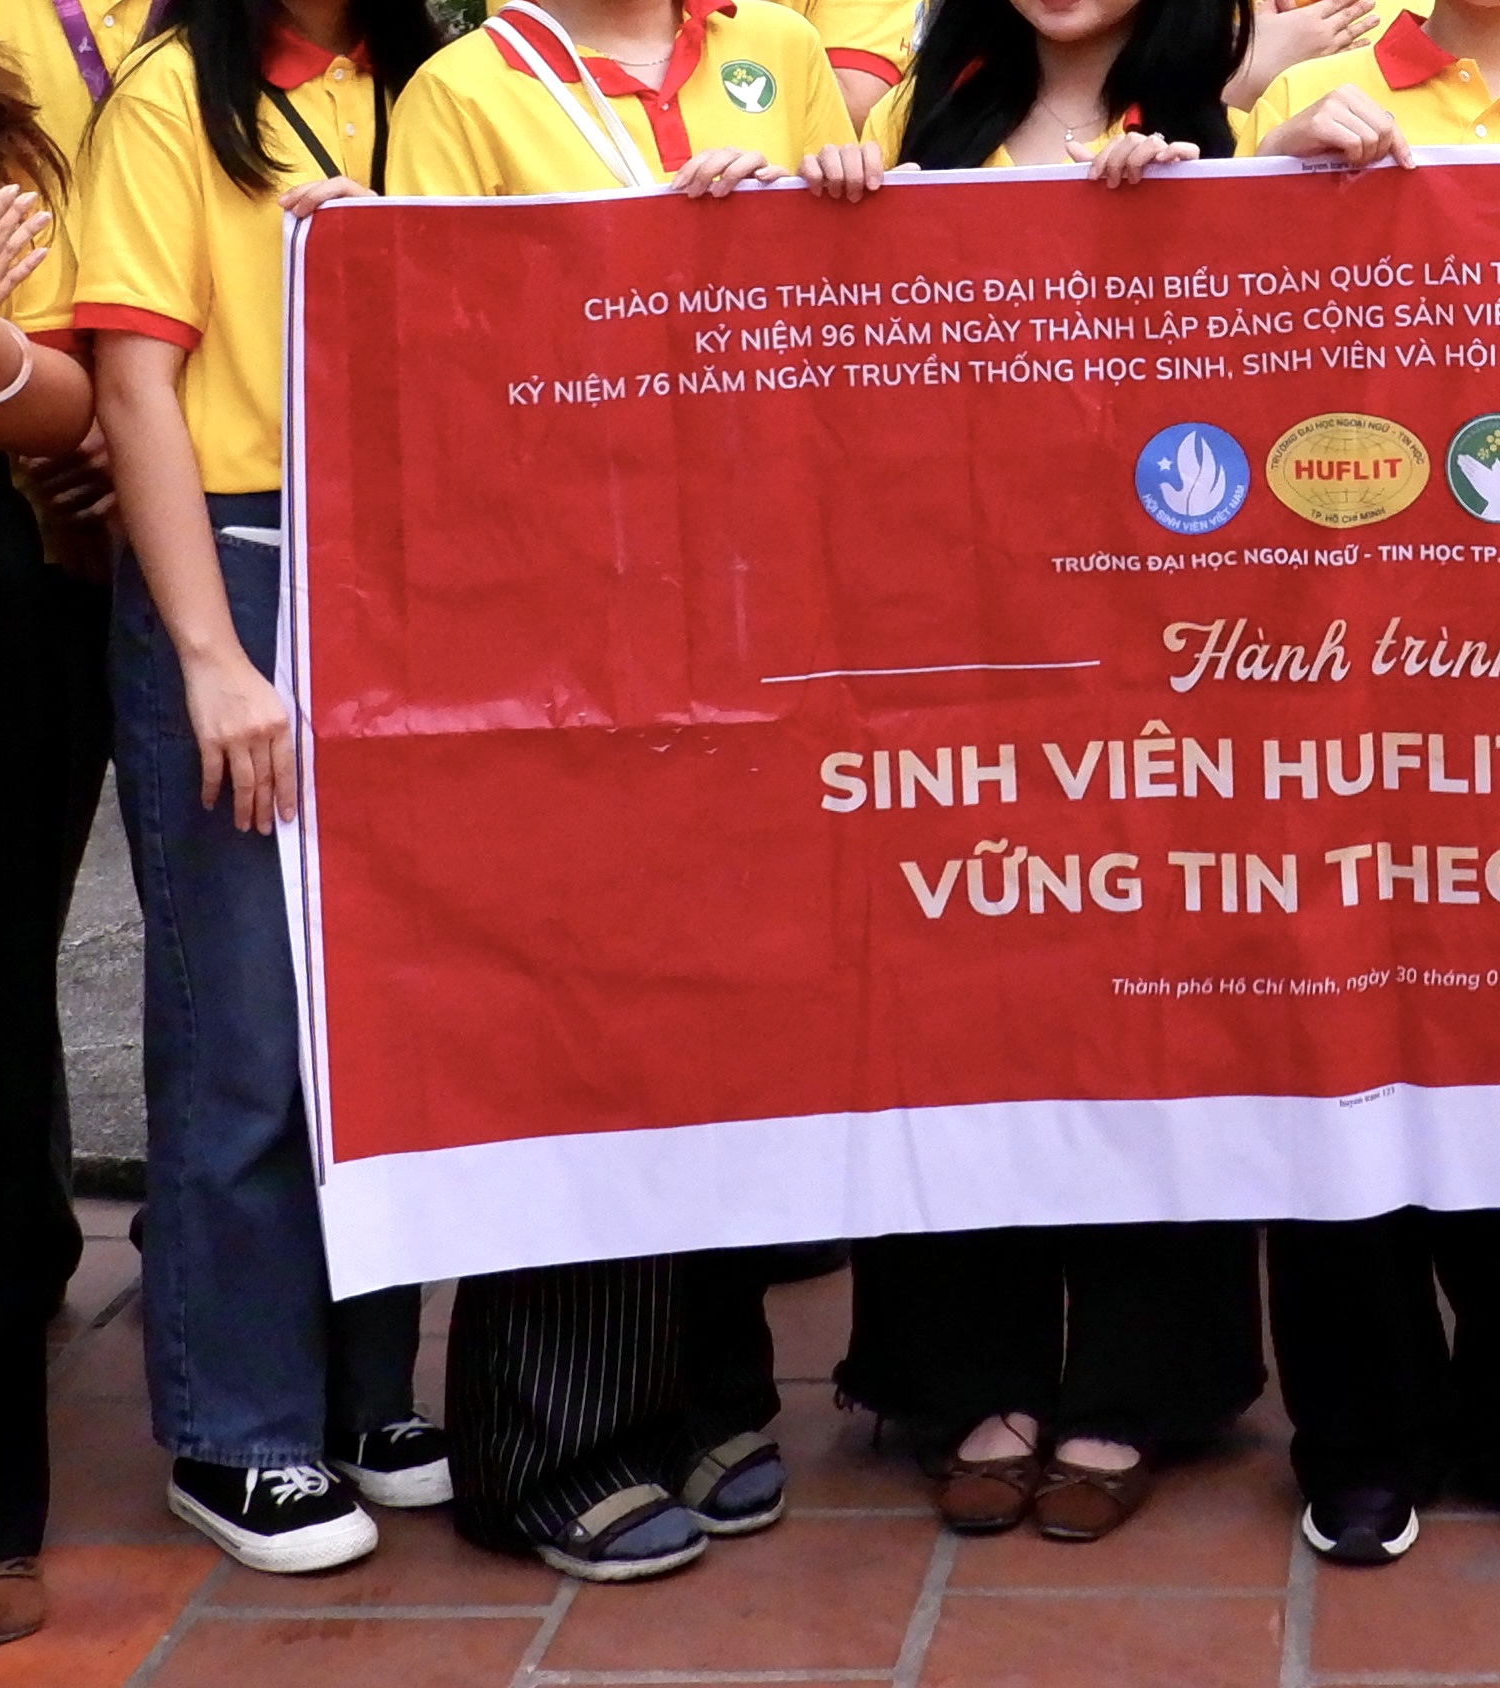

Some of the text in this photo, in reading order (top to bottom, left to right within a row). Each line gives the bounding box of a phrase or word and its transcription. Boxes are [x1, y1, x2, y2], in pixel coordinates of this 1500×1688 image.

[584, 288, 669, 321] CHÀO
[679, 283, 767, 313] MỪNG
[775, 276, 881, 308] THÀNH
[891, 274, 974, 305] CÔNG
[982, 278, 1034, 307] ĐẠI
[1045, 269, 1096, 300] HỘI
[1104, 276, 1154, 305] ĐẠI
[1163, 265, 1229, 299] BIỂU
[1237, 265, 1320, 297] TOÀN
[1330, 255, 1414, 292] QUỐC
[1424, 254, 1482, 286] LẦN
[695, 323, 732, 354] KỶ
[741, 319, 812, 355] NIỆM
[821, 323, 856, 347] 96
[864, 317, 931, 347] NĂM
[941, 313, 1021, 344] NGÀY
[1028, 310, 1134, 342] THÀNH
[1144, 310, 1199, 345] LẬP
[1206, 307, 1293, 339] ĐẢNG
[1303, 299, 1384, 334] CỘNG
[1394, 296, 1454, 327] SẢN
[508, 374, 545, 405] KỶ
[554, 372, 626, 407] NIỆM
[635, 372, 670, 397] 76
[678, 365, 746, 394] NĂM
[755, 359, 836, 392] NGÀY
[842, 353, 960, 387] TRUYỀN
[968, 351, 1074, 383] THỐNG
[1084, 357, 1146, 386] HỌC
[1155, 356, 1233, 380] SINH,
[1242, 348, 1312, 376] SINH
[1320, 339, 1386, 370] VIÊN
[1394, 337, 1436, 368] VÀ
[1445, 337, 1496, 373] HỘI
[1294, 458, 1403, 482] HUFLIT
[1051, 550, 1142, 573] TRƯỜNG
[1146, 554, 1185, 575] ĐẠI
[1191, 550, 1237, 572] HỌC
[1243, 547, 1309, 569] NGOẠI
[1314, 543, 1359, 567] NGỮ
[1377, 544, 1413, 562] TIN
[1420, 544, 1465, 565] HỌC
[1163, 618, 1352, 693] Hành
[820, 744, 1017, 813] SINH
[1041, 719, 1234, 801] VIÊN
[899, 838, 1143, 919] VỮNG
[1167, 851, 1298, 914] TIN
[1112, 977, 1171, 996] Thành
[1176, 978, 1213, 999] phố
[1252, 978, 1284, 995] Chí
[1289, 976, 1341, 995] Minh,
[1346, 968, 1391, 992] ngày
[1395, 965, 1418, 984] 30
[1423, 968, 1480, 991] tháng
